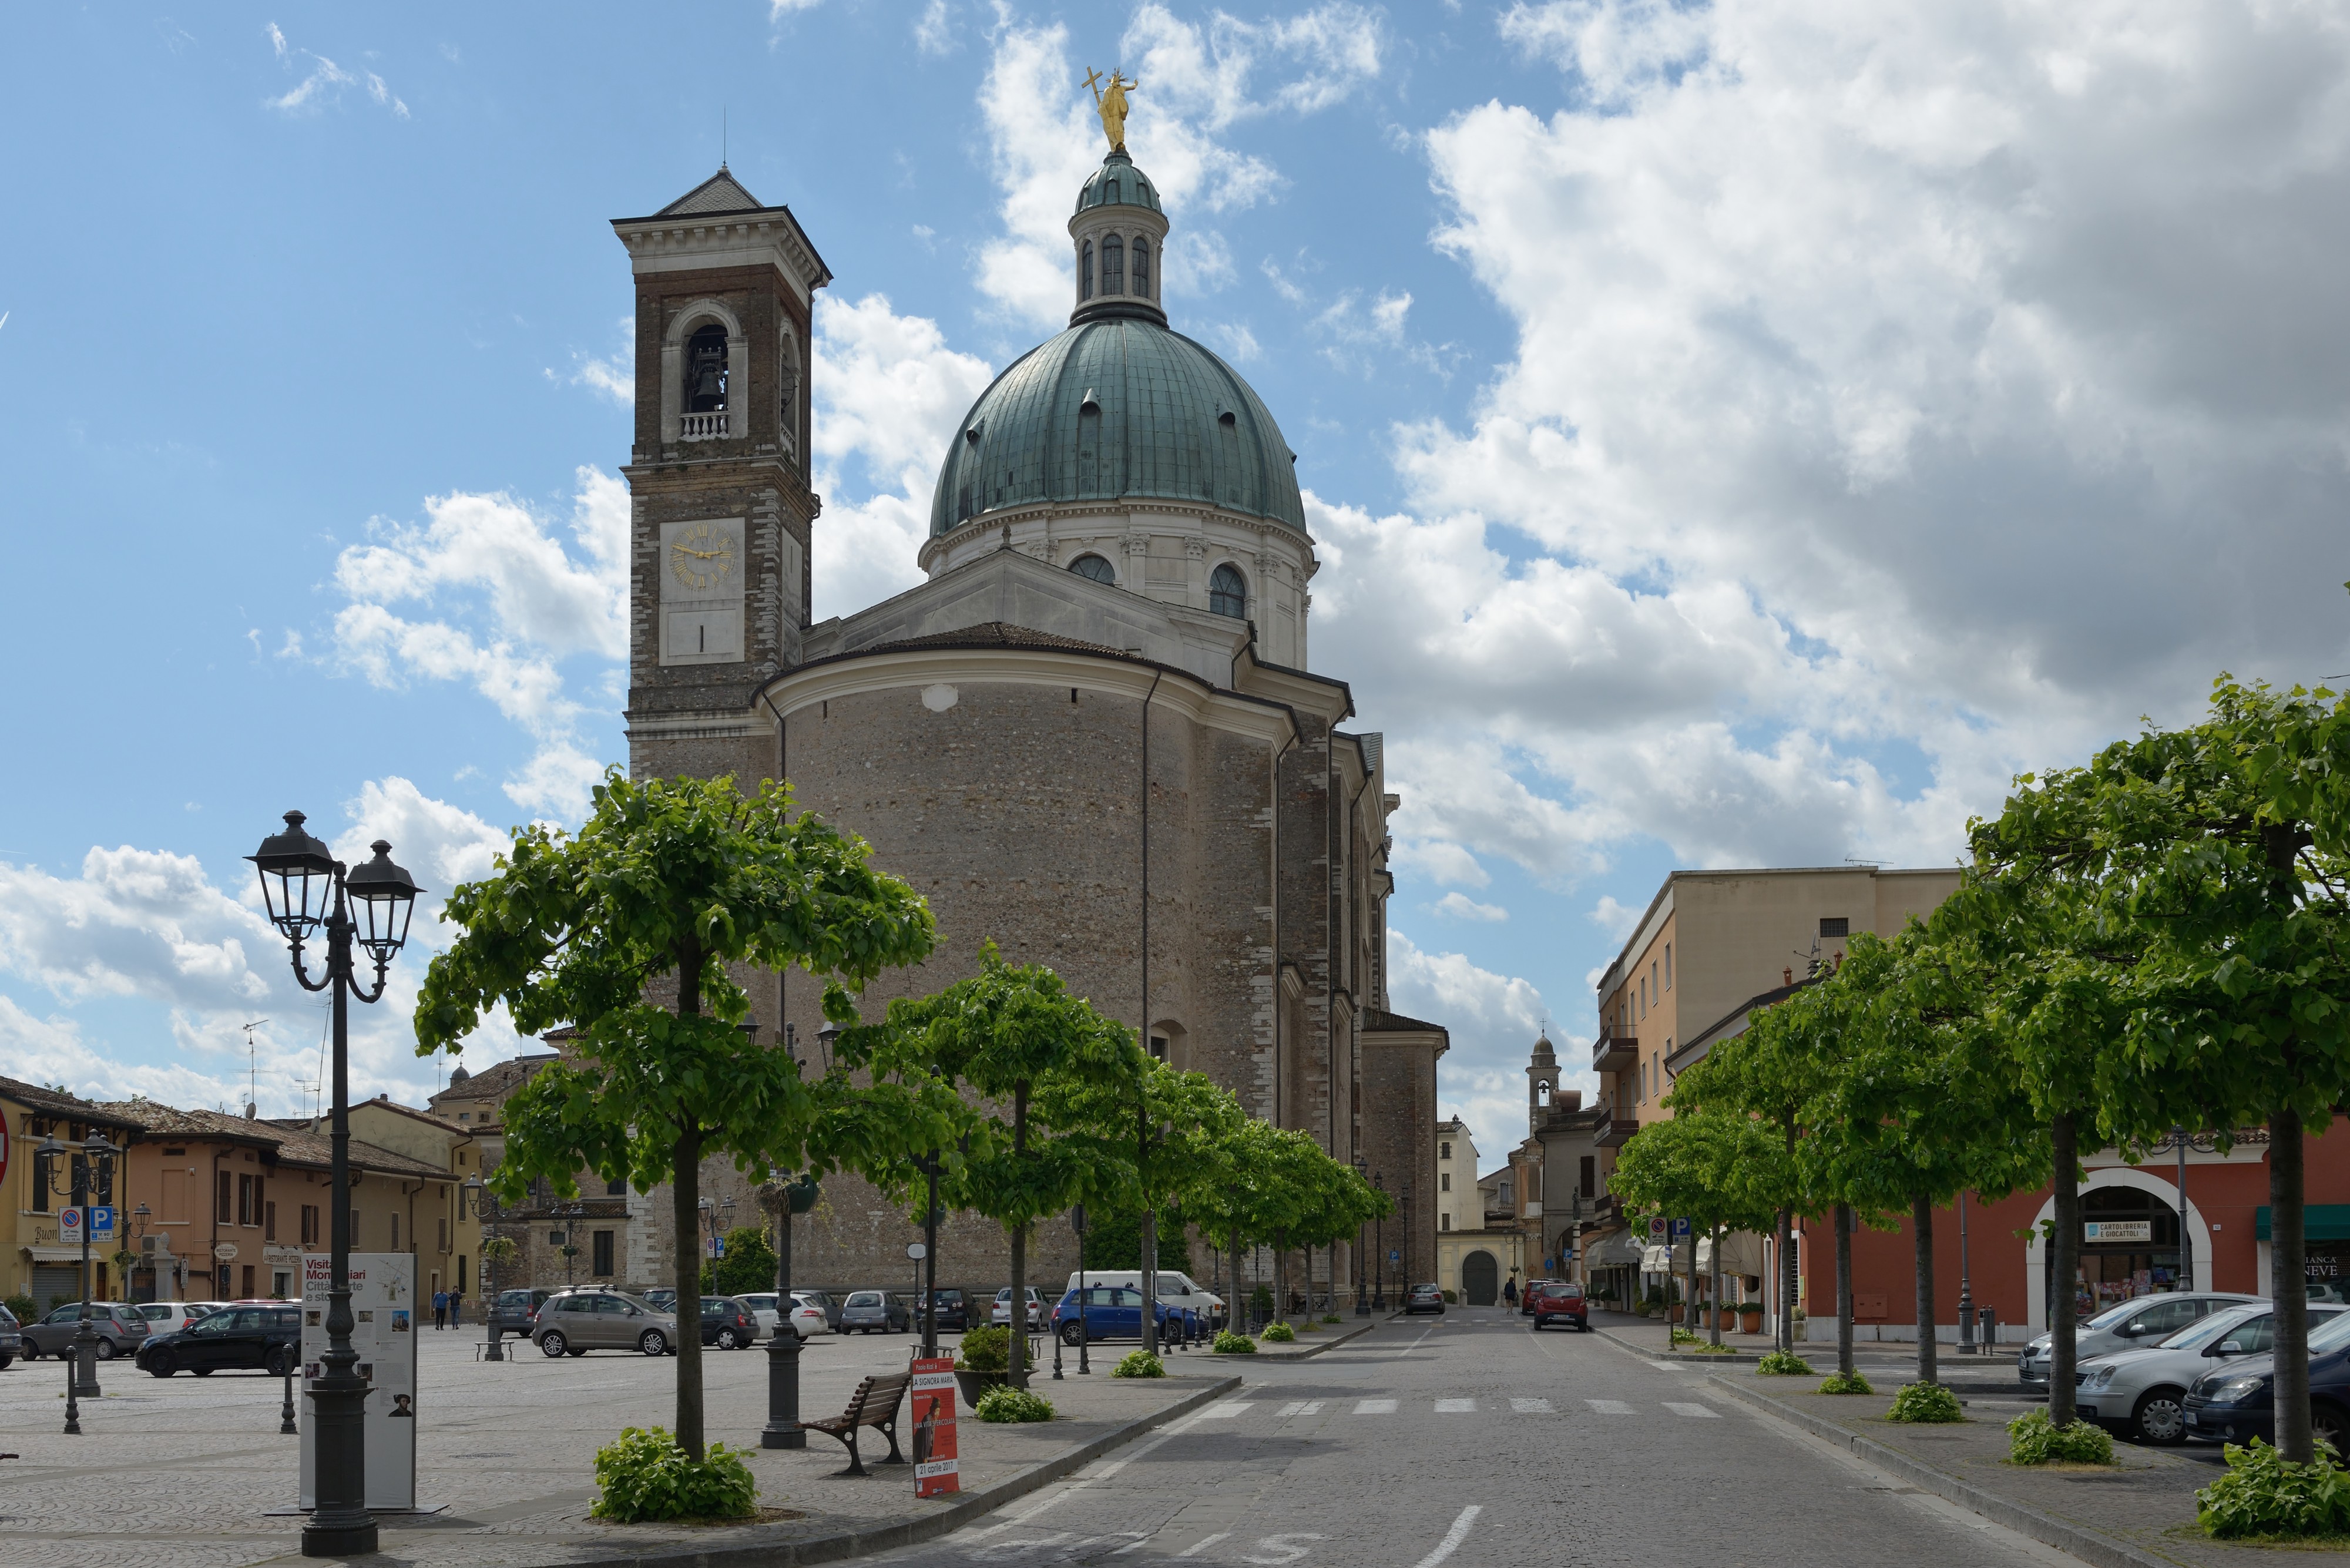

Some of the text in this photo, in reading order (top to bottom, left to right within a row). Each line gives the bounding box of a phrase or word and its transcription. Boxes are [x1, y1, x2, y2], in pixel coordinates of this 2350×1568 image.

[697, 525, 708, 537] XII
[711, 528, 717, 539] I
[718, 538, 730, 548] II
[95, 1210, 108, 1227] P
[1676, 1218, 1688, 1234] P
[35, 1226, 57, 1240] Buon
[717, 1239, 722, 1250] P
[268, 1255, 287, 1263] RISTORANTE
[306, 1281, 330, 1291] Città
[315, 1294, 331, 1302] sto
[919, 1377, 940, 1386] SIGNORA
[932, 1418, 955, 1427] SPERICOLATA
[920, 1462, 953, 1475] 21 aprile 2017
